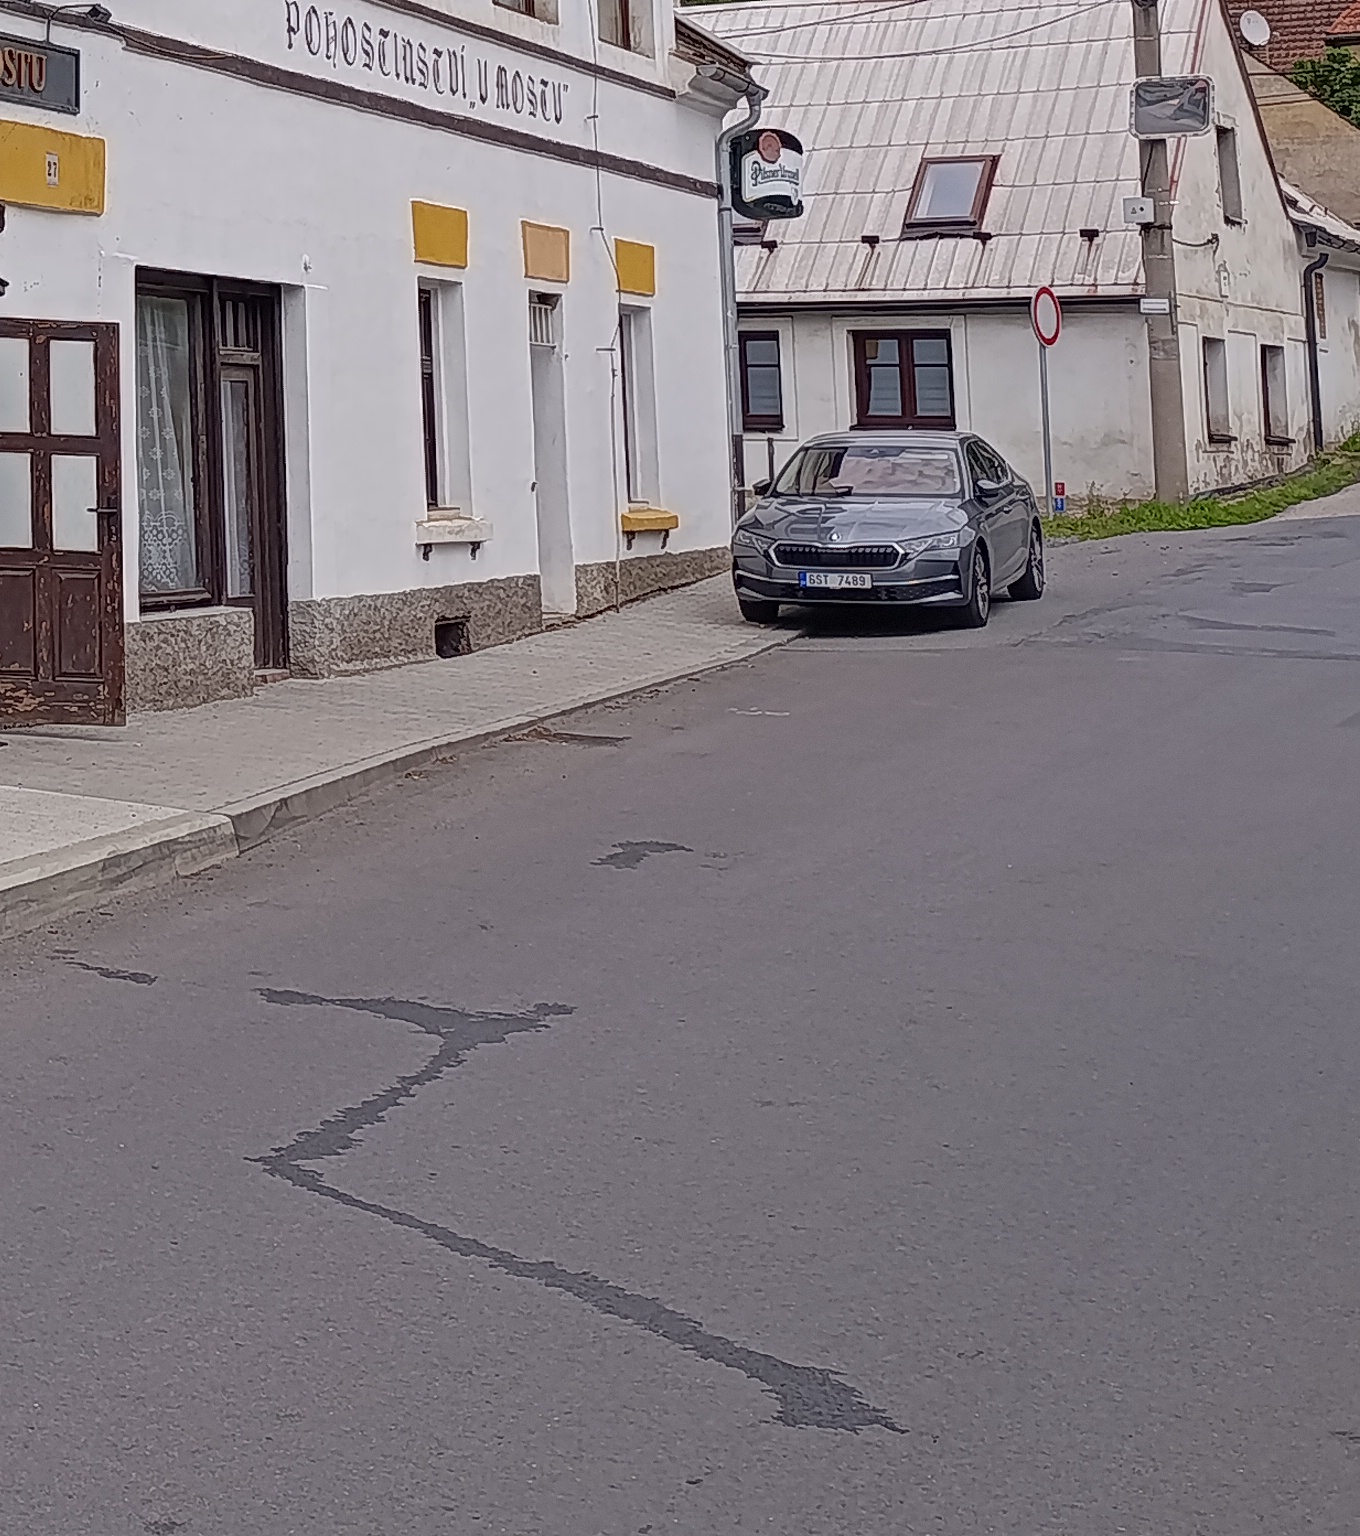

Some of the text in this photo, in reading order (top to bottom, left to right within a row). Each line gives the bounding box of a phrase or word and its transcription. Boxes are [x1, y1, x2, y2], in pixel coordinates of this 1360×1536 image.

[285, 0, 467, 100] POHOSTINSTVÍ
[47, 160, 57, 178] 27
[808, 573, 866, 586] 6ST 7489
